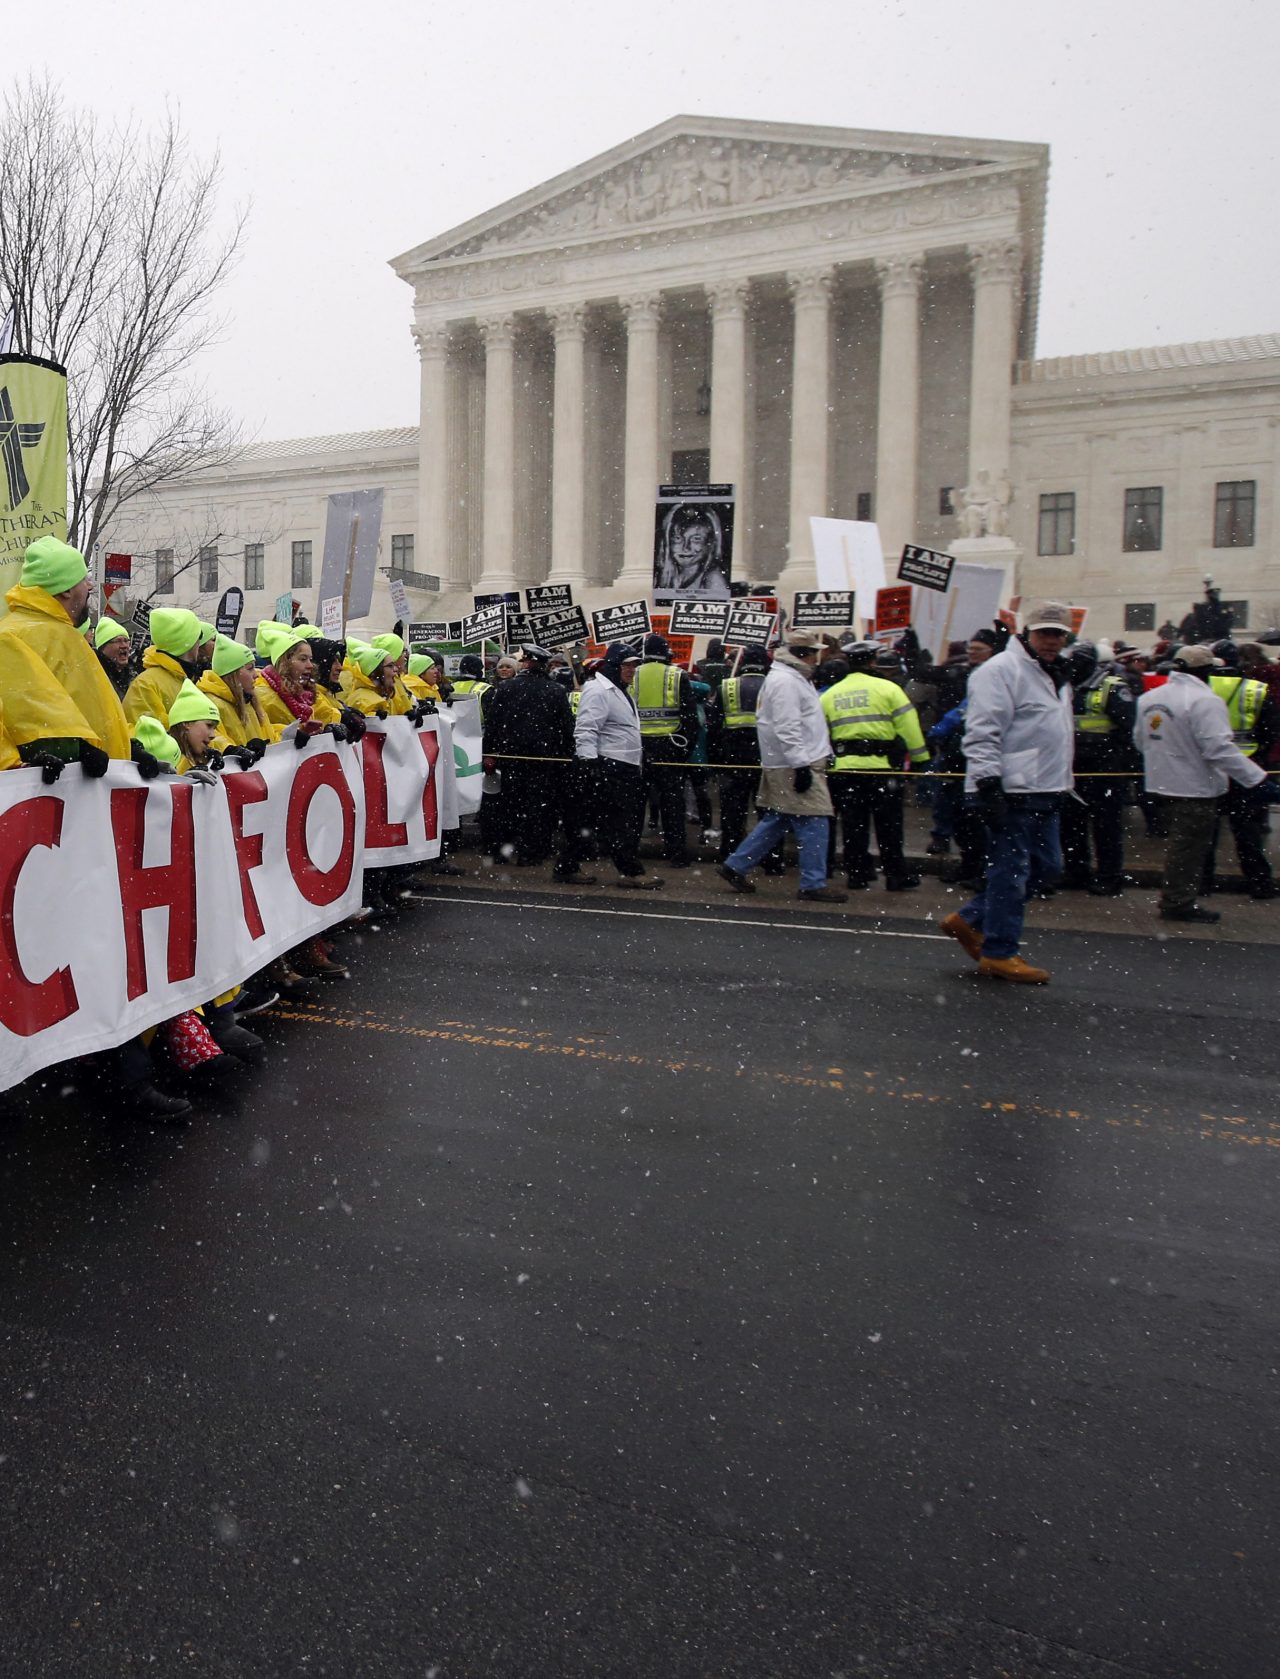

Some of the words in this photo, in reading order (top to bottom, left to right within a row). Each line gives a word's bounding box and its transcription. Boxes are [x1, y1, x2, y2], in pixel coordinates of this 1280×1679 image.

[31, 501, 43, 511] THE
[906, 546, 916, 559] I
[918, 550, 951, 569] AM
[903, 562, 948, 580] PRO-LIFE
[529, 589, 537, 599] I
[540, 585, 568, 598] AM
[798, 594, 809, 605] I
[811, 593, 850, 604] AM
[531, 599, 569, 609] PRO-LIFE
[677, 603, 688, 613] I
[690, 604, 727, 615] AM
[466, 616, 473, 627] I
[475, 607, 502, 623] AM
[533, 619, 543, 630] I
[546, 608, 580, 627] AM
[596, 612, 606, 622] I
[608, 603, 643, 620] AM
[798, 608, 850, 616] PRO-LIFE
[466, 619, 503, 635] PRO-LIFE
[510, 616, 518, 625] I
[598, 616, 645, 632] PRO-LIFE
[676, 617, 725, 625] PRO-LIFE
[732, 613, 741, 623] I
[742, 615, 772, 627] AM
[466, 624, 502, 640] GENERATION
[538, 622, 583, 639] PRO-LIFE
[599, 624, 646, 637] GENERATION
[729, 627, 767, 637] PRO-LIFE
[834, 694, 870, 711] POLICE
[221, 752, 360, 941] FO
[361, 730, 439, 849] LI
